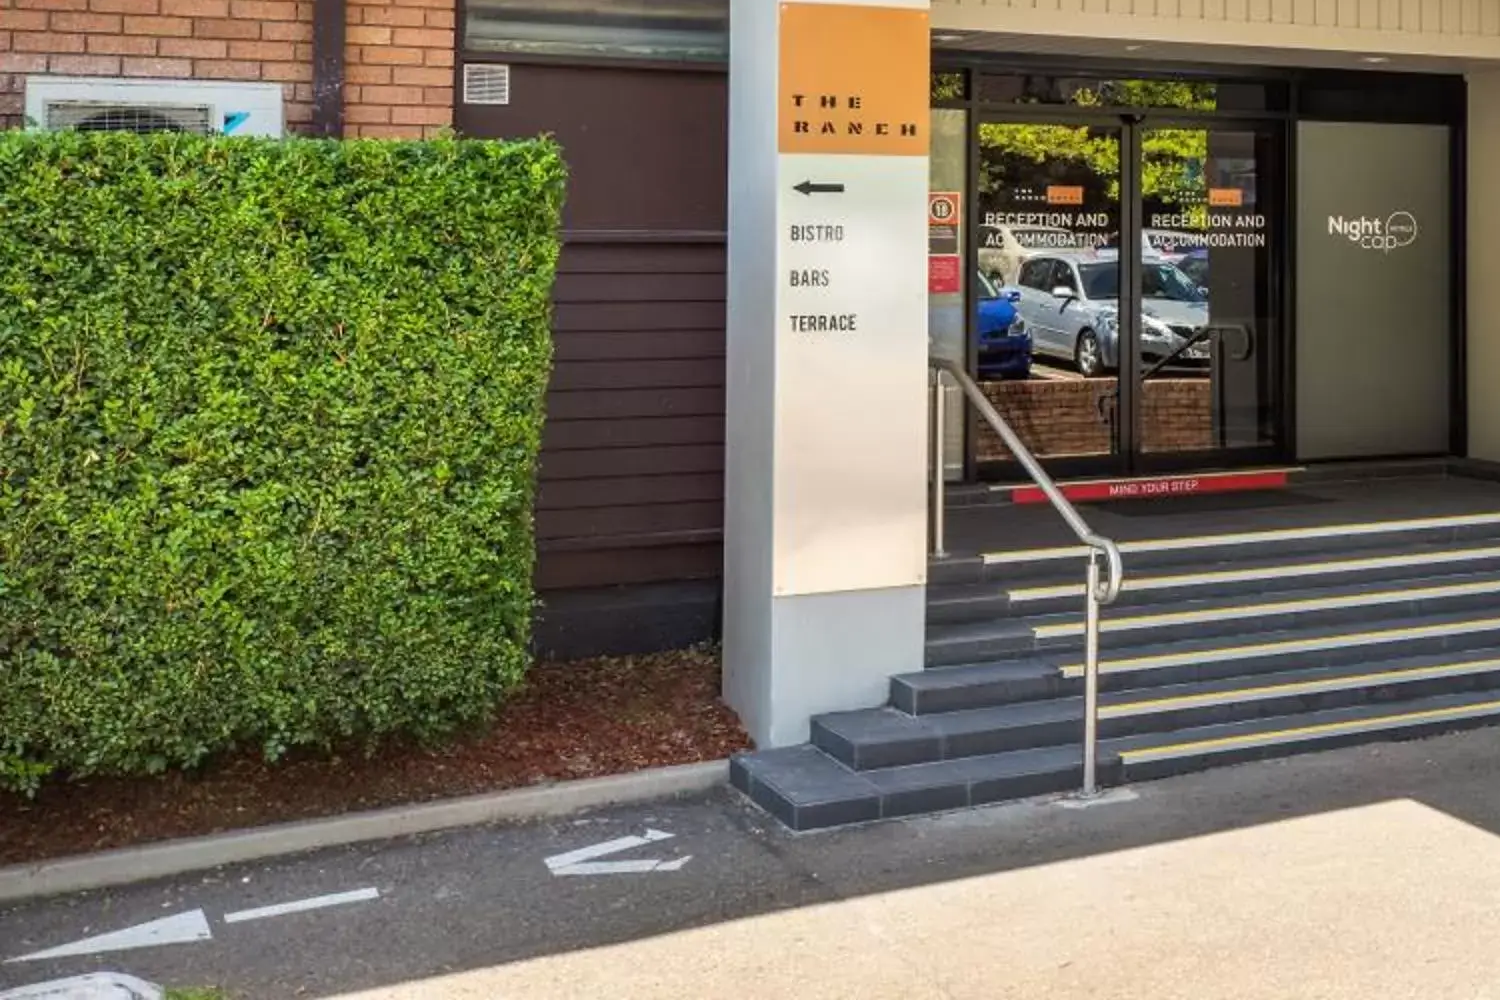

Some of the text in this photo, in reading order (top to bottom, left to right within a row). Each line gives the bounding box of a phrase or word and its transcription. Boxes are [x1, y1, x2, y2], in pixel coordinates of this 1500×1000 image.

[792, 95, 861, 109] THE
[794, 121, 916, 136] RANCH
[985, 212, 1109, 227] RECEPTION AND
[1151, 213, 1265, 228] RECEPTION AND
[790, 225, 844, 242] BISTRO
[1327, 215, 1381, 241] Night
[985, 232, 1109, 247] ACOMMODATION
[1151, 232, 1265, 247] ACCOMMODATION
[1360, 235, 1398, 256] cap
[789, 270, 830, 287] BARS
[789, 315, 857, 332] TERRACE
[1109, 479, 1199, 497] MIND YOUR STEP
